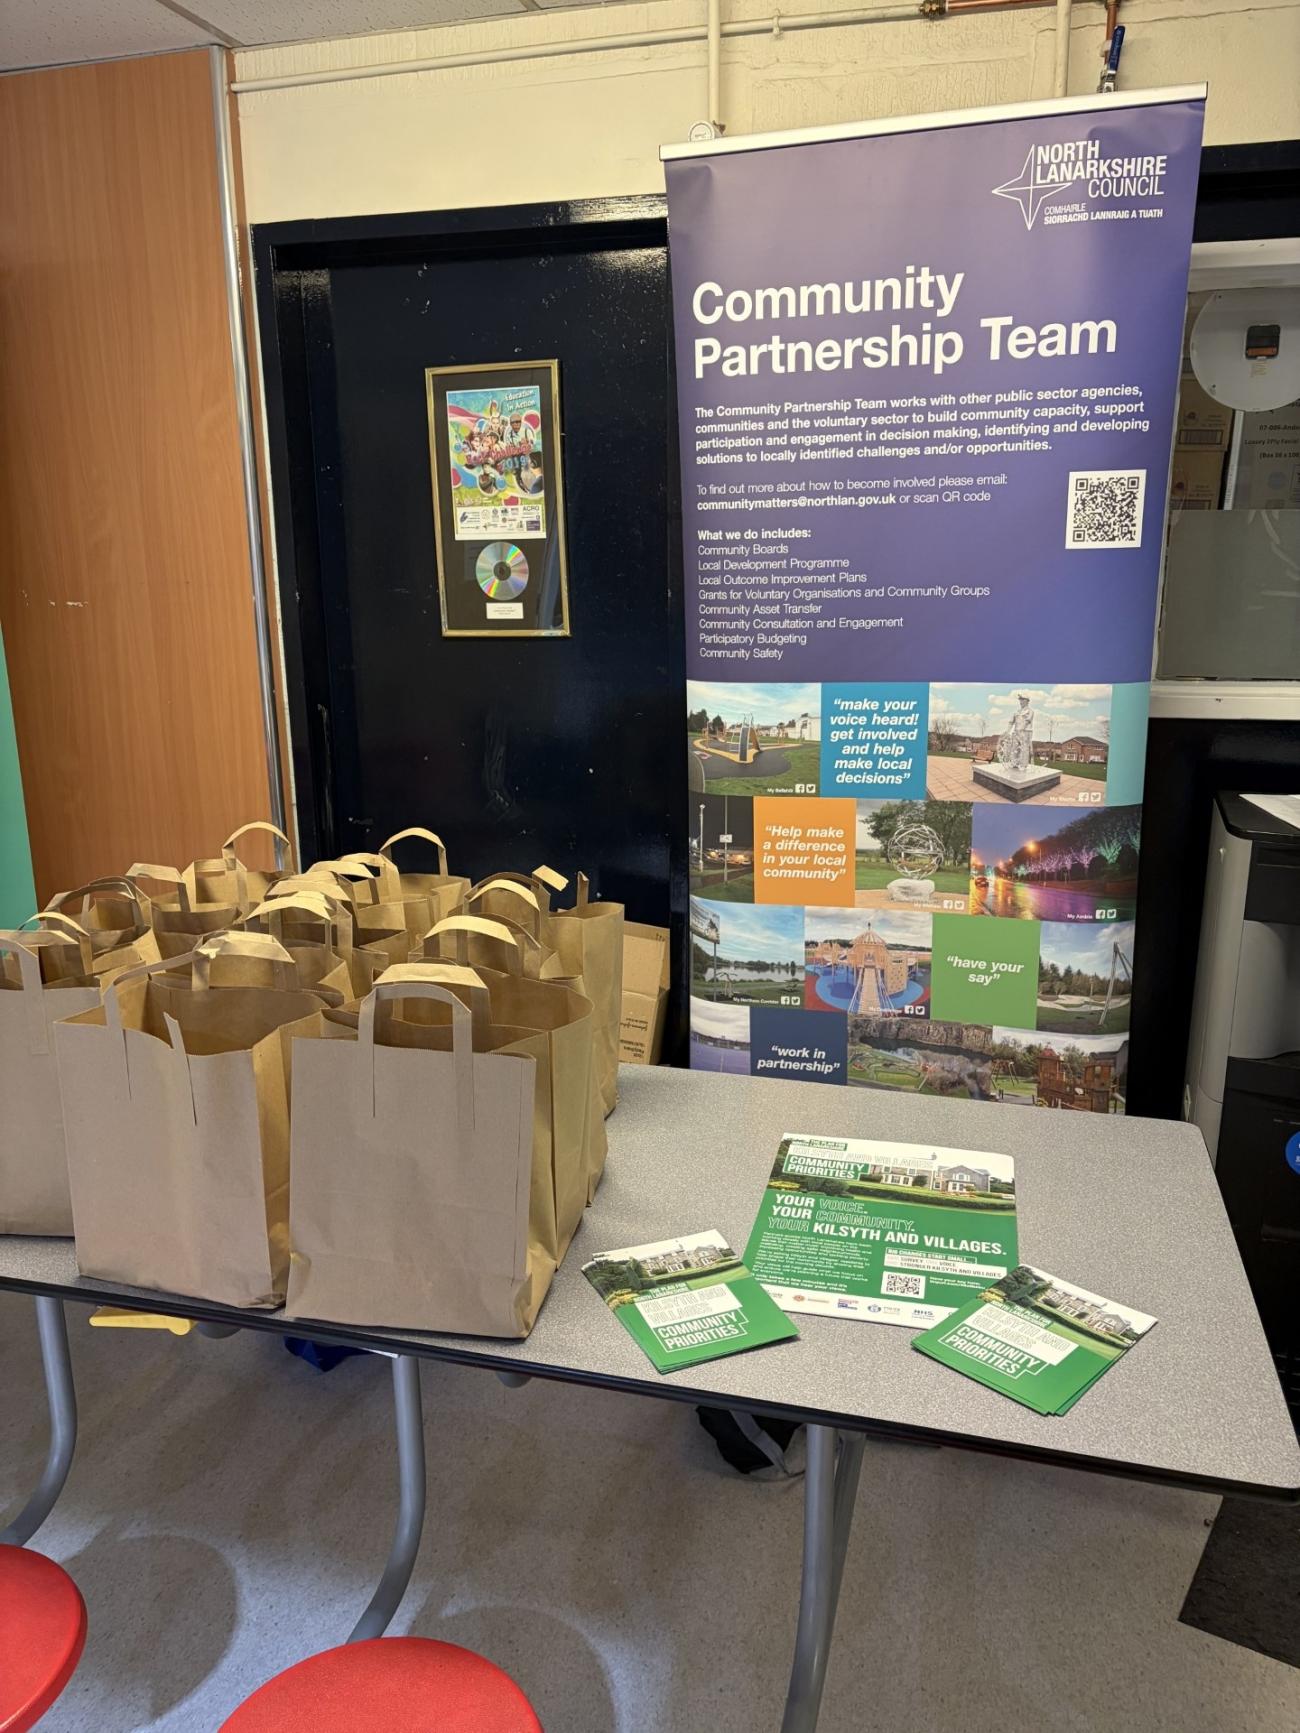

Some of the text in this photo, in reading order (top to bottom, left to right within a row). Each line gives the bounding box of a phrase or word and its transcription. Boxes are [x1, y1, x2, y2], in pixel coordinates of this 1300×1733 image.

[1037, 140, 1100, 164] NORTH
[1036, 156, 1167, 184] LANARKSHIRE
[1088, 176, 1164, 198] COUNCIL
[1044, 203, 1086, 216] COMHAIRLE
[1044, 209, 1163, 225] SIORRACHD LANNRAIG A TUATH
[692, 265, 965, 325] Community
[694, 315, 1118, 379] Partnership Team
[695, 384, 1143, 418] The Community Partnership Team works with other public sector agencies,
[695, 401, 1144, 434] communities and the voluntary sector to build community capacity, support
[696, 418, 1150, 451] participation and engagement in decision making, identifying and developing
[696, 439, 1052, 464] solutions to locally identified challenges and/or opportunities.
[697, 474, 1008, 495] To find out more about how to become involved please email:
[697, 491, 991, 511] communitymatters@northlan.gov.uk or scan QR code
[698, 527, 812, 541] What we do includes:
[698, 544, 789, 557] Community Boards
[699, 558, 850, 572] Local Development Programme
[699, 572, 867, 586] Local Outcome Improvement Plans
[699, 585, 990, 603] Grants for Voluntary Organisations and Community Groups
[699, 603, 822, 617] Community Asset Transfer
[699, 617, 904, 632] Community Consultation and Engagement
[700, 633, 807, 646] Participatory Budgeting
[700, 648, 783, 661] Community Safety
[883, 700, 918, 713] your
[830, 713, 920, 726] voice heard!
[830, 728, 918, 742] get involved
[842, 743, 905, 757] and help
[834, 758, 913, 770] make local
[807, 827, 844, 838] make
[763, 839, 846, 852] a difference
[763, 852, 847, 867] in your local
[990, 962, 1025, 973] your
[813, 1048, 826, 1059] in
[790, 1156, 865, 1171] COMMUNITY
[787, 1164, 855, 1179] PRIORITIES
[775, 1194, 868, 1214] YOUR VOICE.
[772, 1205, 916, 1232] YOUR COMMUNITY.
[768, 1217, 1007, 1255] YOUR KILSYTH AND VILLAGES.
[658, 1312, 738, 1338] COMMUNITY
[664, 1325, 739, 1349] PRIORITIES
[945, 1335, 1020, 1374] PRIORITIES
[957, 1326, 1040, 1368] COMMUNITY
